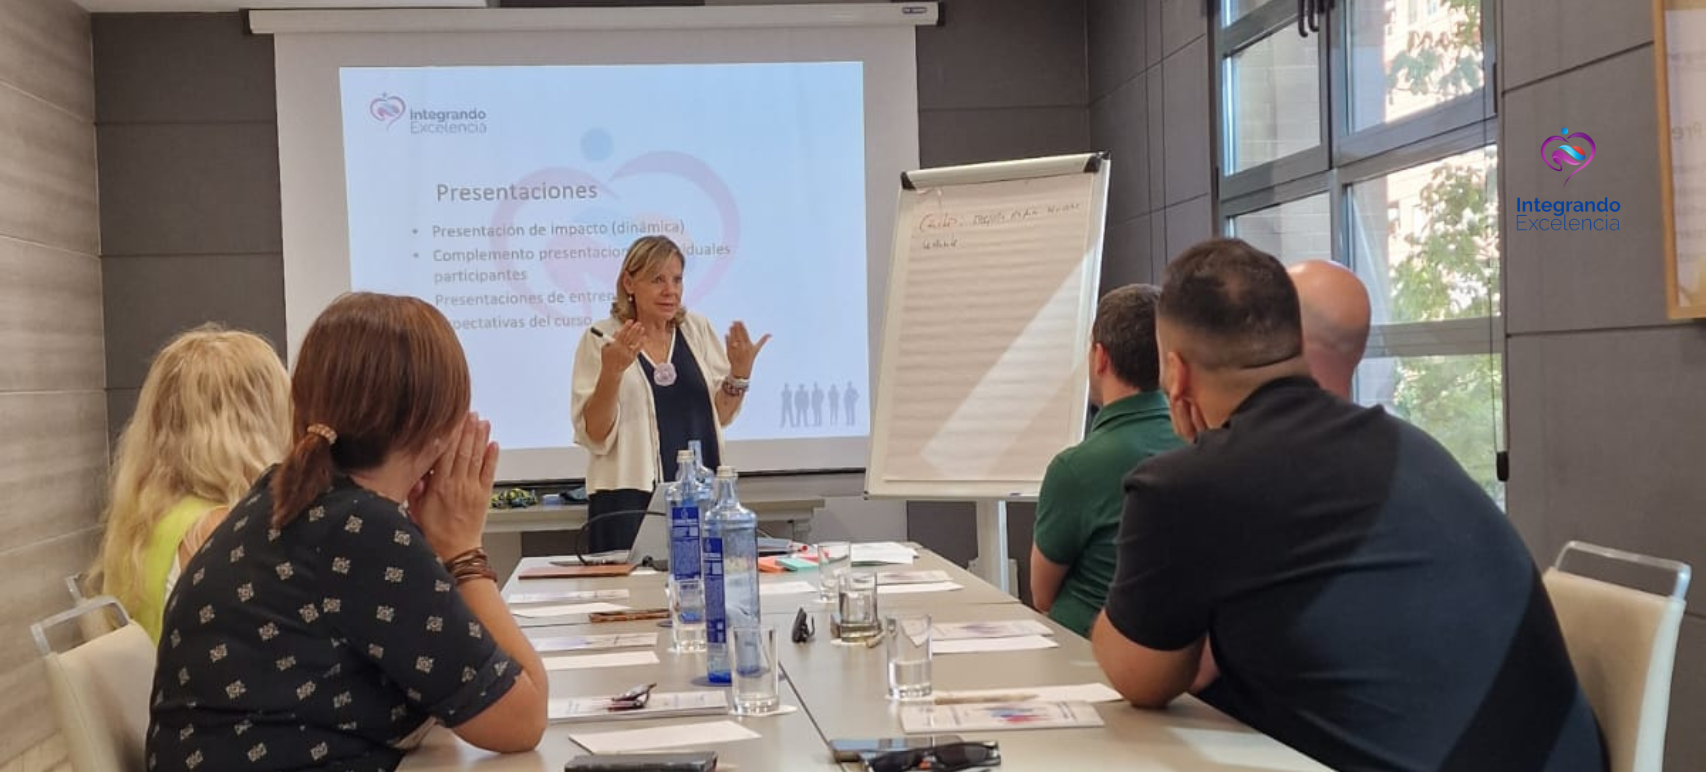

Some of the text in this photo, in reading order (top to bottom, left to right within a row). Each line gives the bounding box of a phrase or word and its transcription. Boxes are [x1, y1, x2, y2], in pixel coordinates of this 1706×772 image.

[410, 108, 487, 122] Integrando
[410, 121, 487, 134] Excelencia
[437, 182, 598, 201] Presentaciones
[432, 219, 685, 239] Presentación de impacto (dinámica)
[433, 242, 731, 263] Complemento presentacion iduales
[434, 268, 528, 285] participantes
[435, 291, 617, 307] Presentaciones de entren
[452, 313, 593, 332] pectativas del curso
